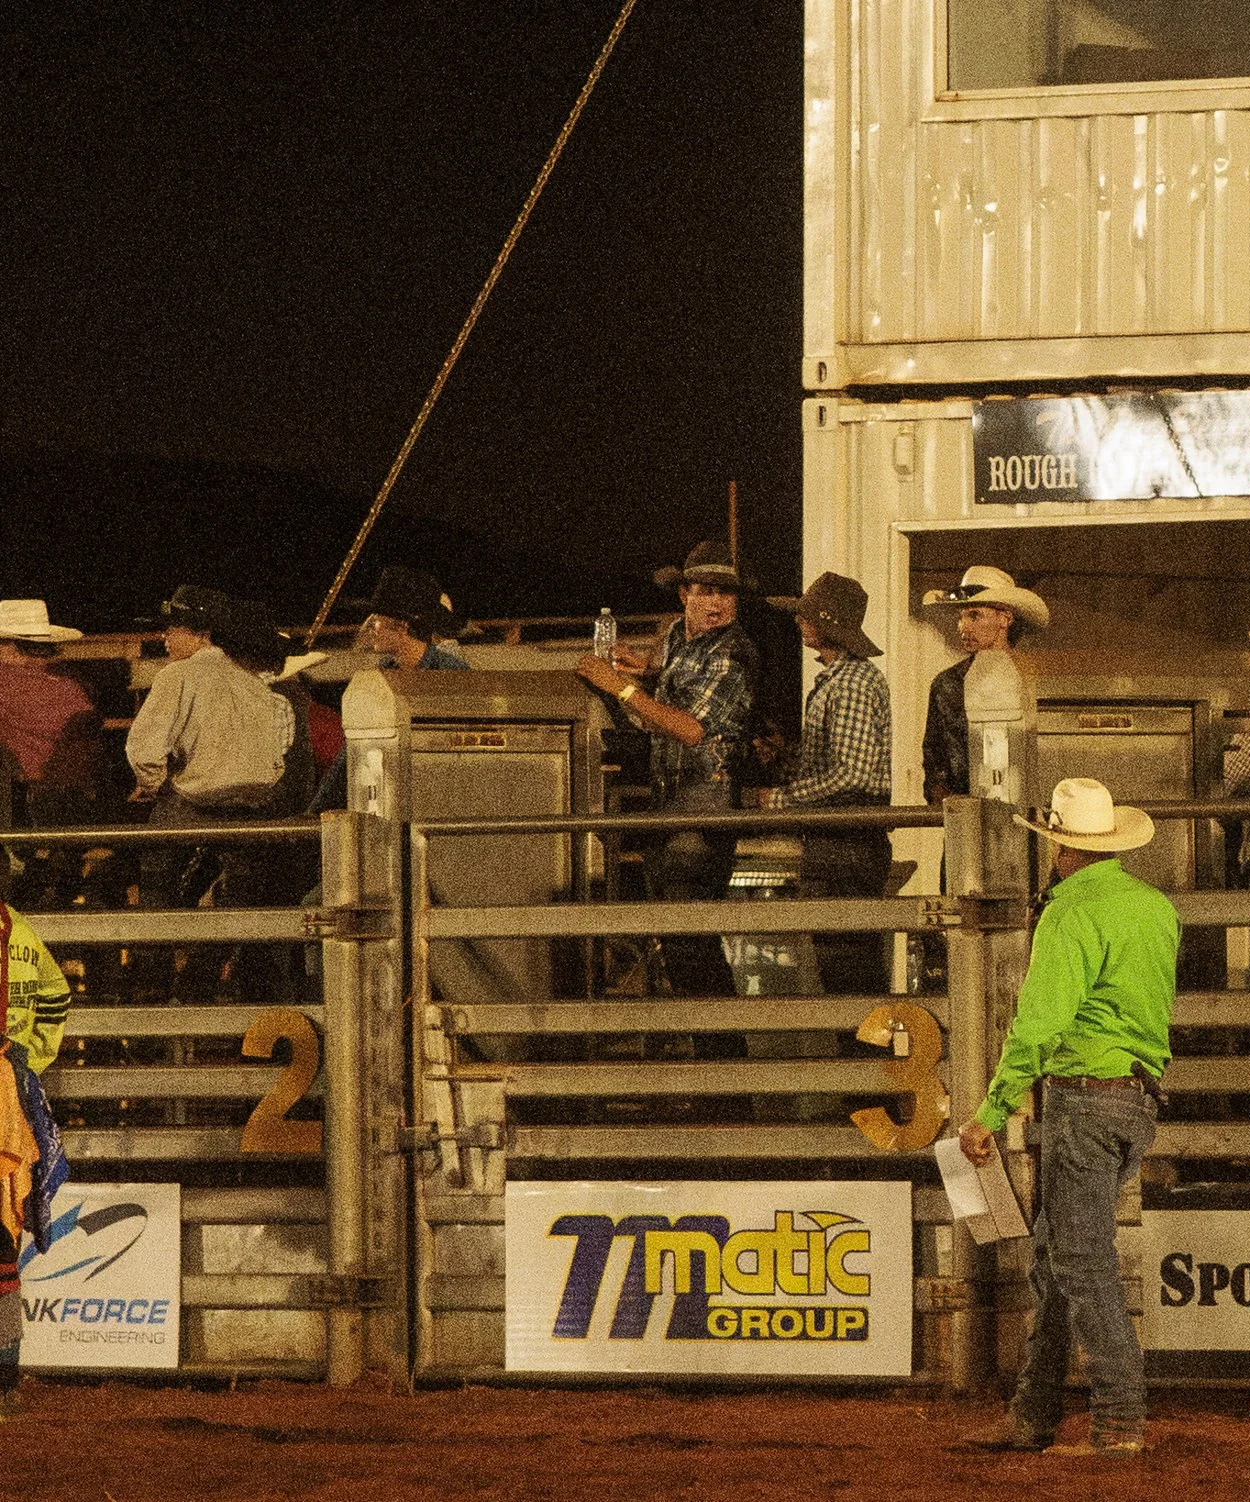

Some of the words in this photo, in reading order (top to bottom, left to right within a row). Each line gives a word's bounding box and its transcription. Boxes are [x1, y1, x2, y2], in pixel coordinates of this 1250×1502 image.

[987, 453, 1079, 491] ROUGH
[239, 1009, 324, 1152] 2
[850, 1002, 943, 1150] 3
[59, 1329, 166, 1345] ENGINEERING
[706, 1307, 867, 1339] GROUP
